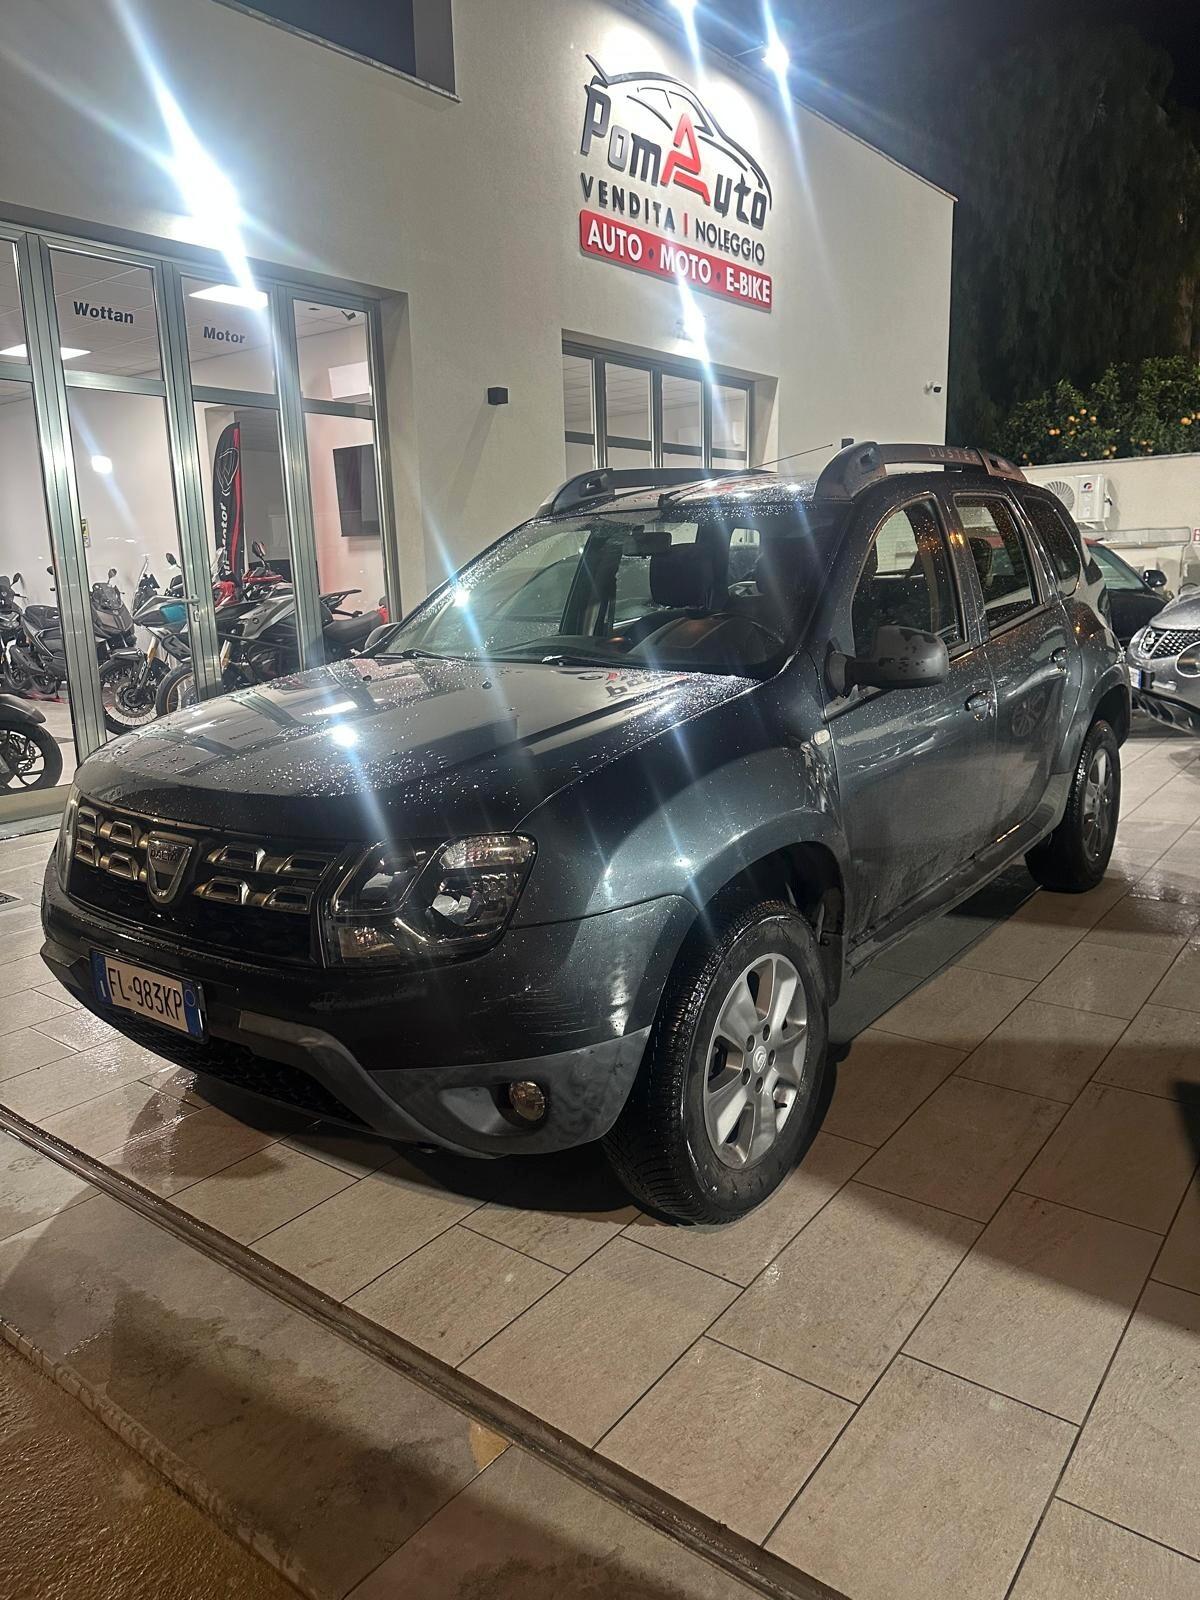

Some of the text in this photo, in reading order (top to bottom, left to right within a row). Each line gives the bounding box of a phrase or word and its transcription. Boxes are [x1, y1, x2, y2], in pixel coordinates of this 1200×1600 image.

[580, 172, 766, 265] VENDITA NOLEGGIO
[587, 219, 770, 303] AUTO MOTO E-BIKE
[73, 301, 246, 344] Wottan Motor
[928, 447, 979, 462] DUSTER
